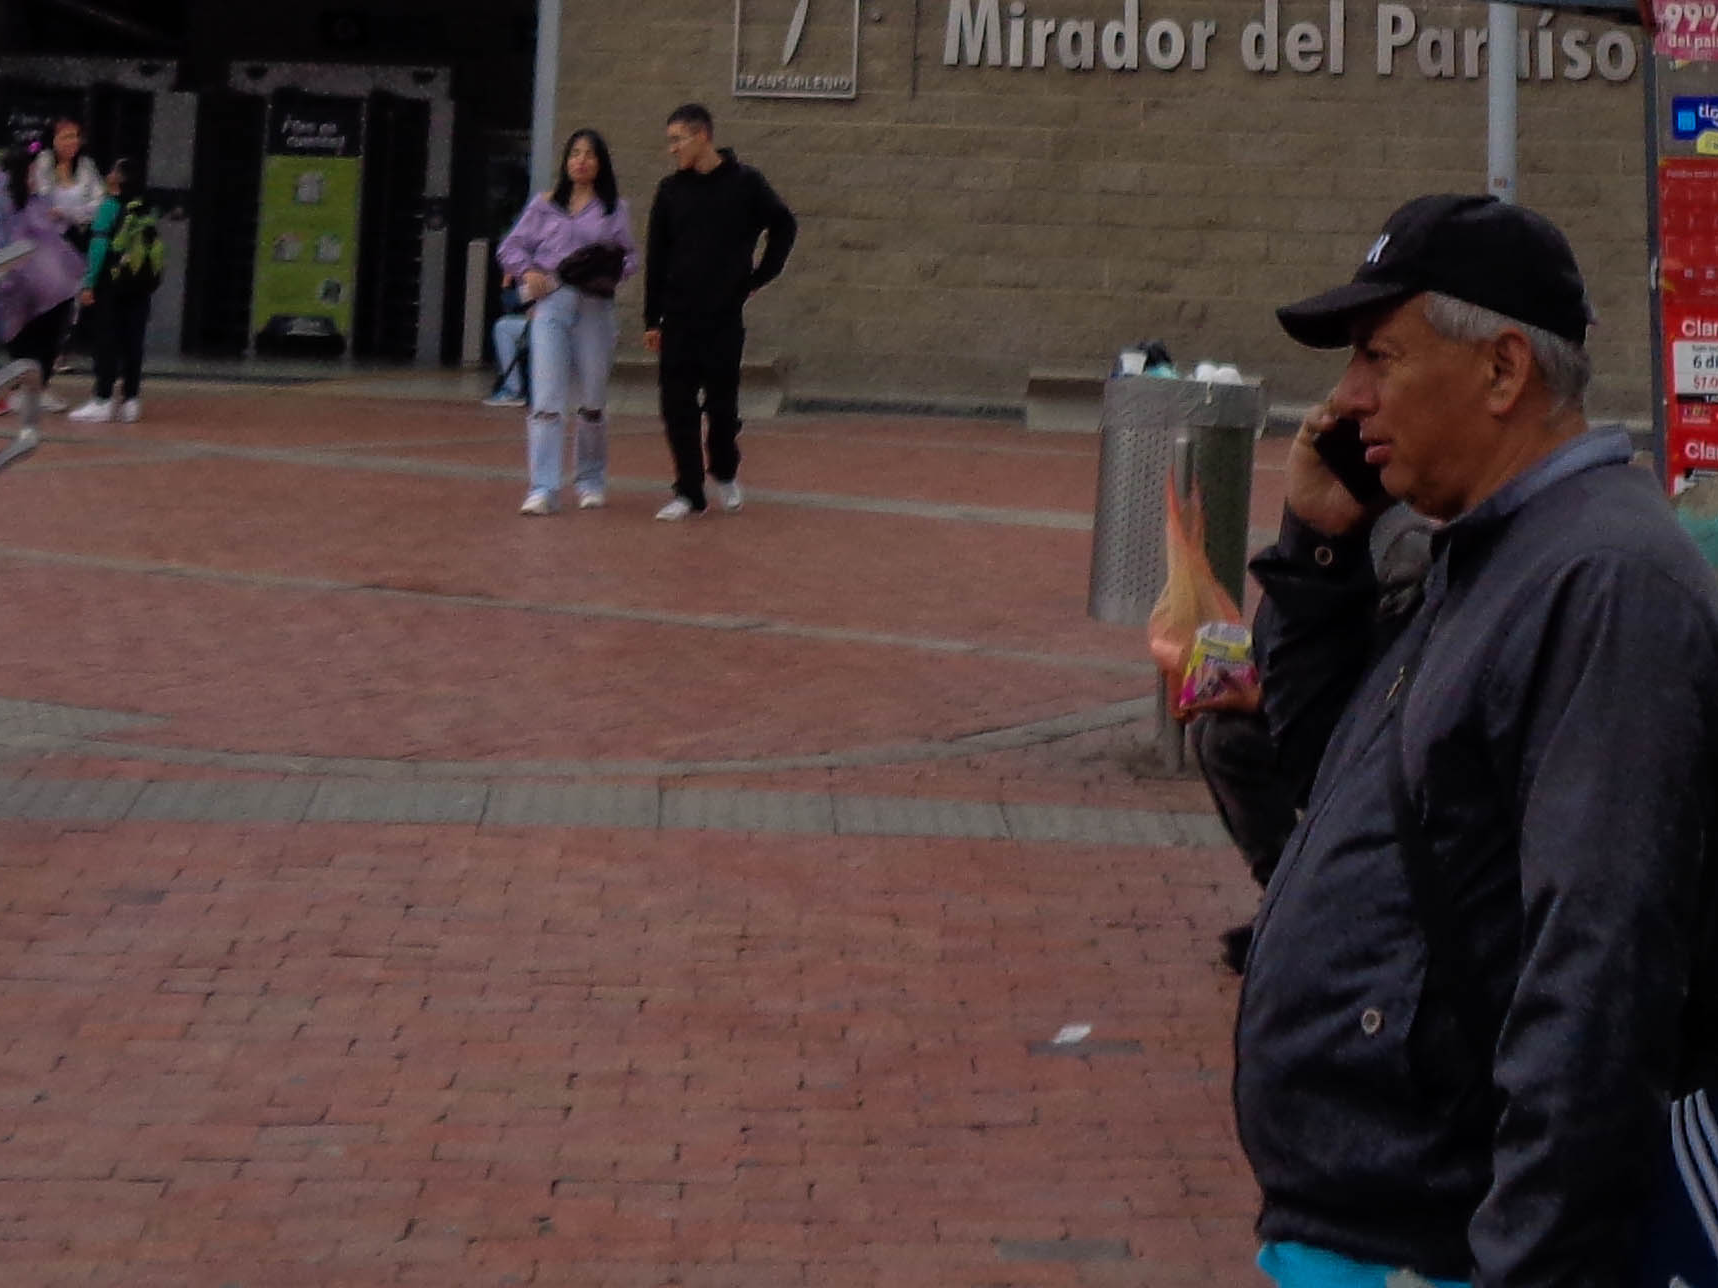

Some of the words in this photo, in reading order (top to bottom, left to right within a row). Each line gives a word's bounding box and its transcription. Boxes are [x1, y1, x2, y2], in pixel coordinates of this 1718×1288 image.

[1668, 32, 1691, 48] del
[738, 74, 851, 91] TRANSMILENIO
[1693, 354, 1702, 369] 6
